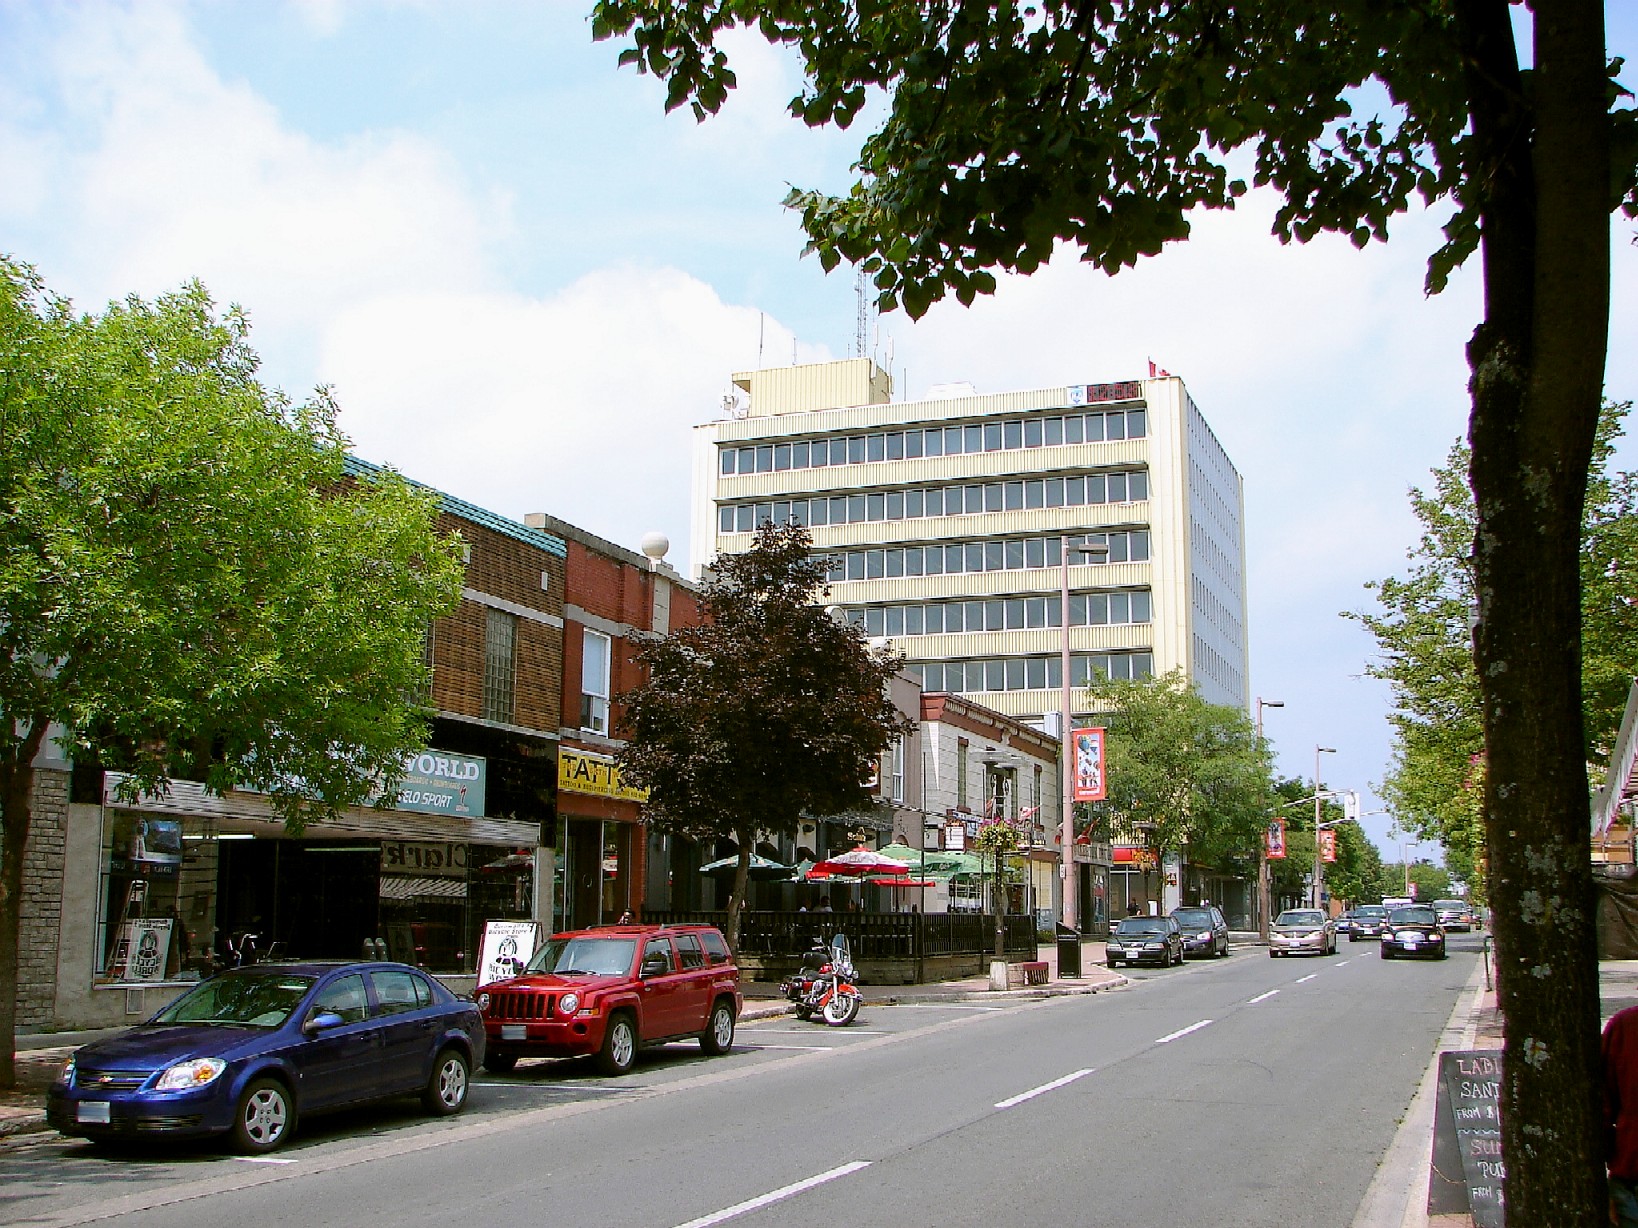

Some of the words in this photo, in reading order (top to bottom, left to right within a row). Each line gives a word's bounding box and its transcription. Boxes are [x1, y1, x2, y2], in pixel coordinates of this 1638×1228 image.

[562, 754, 618, 784] TATT
[421, 792, 453, 808] SPORT
[1456, 1057, 1502, 1075] LADI
[1456, 1106, 1481, 1120] FROM
[1471, 1185, 1492, 1200] FROM
